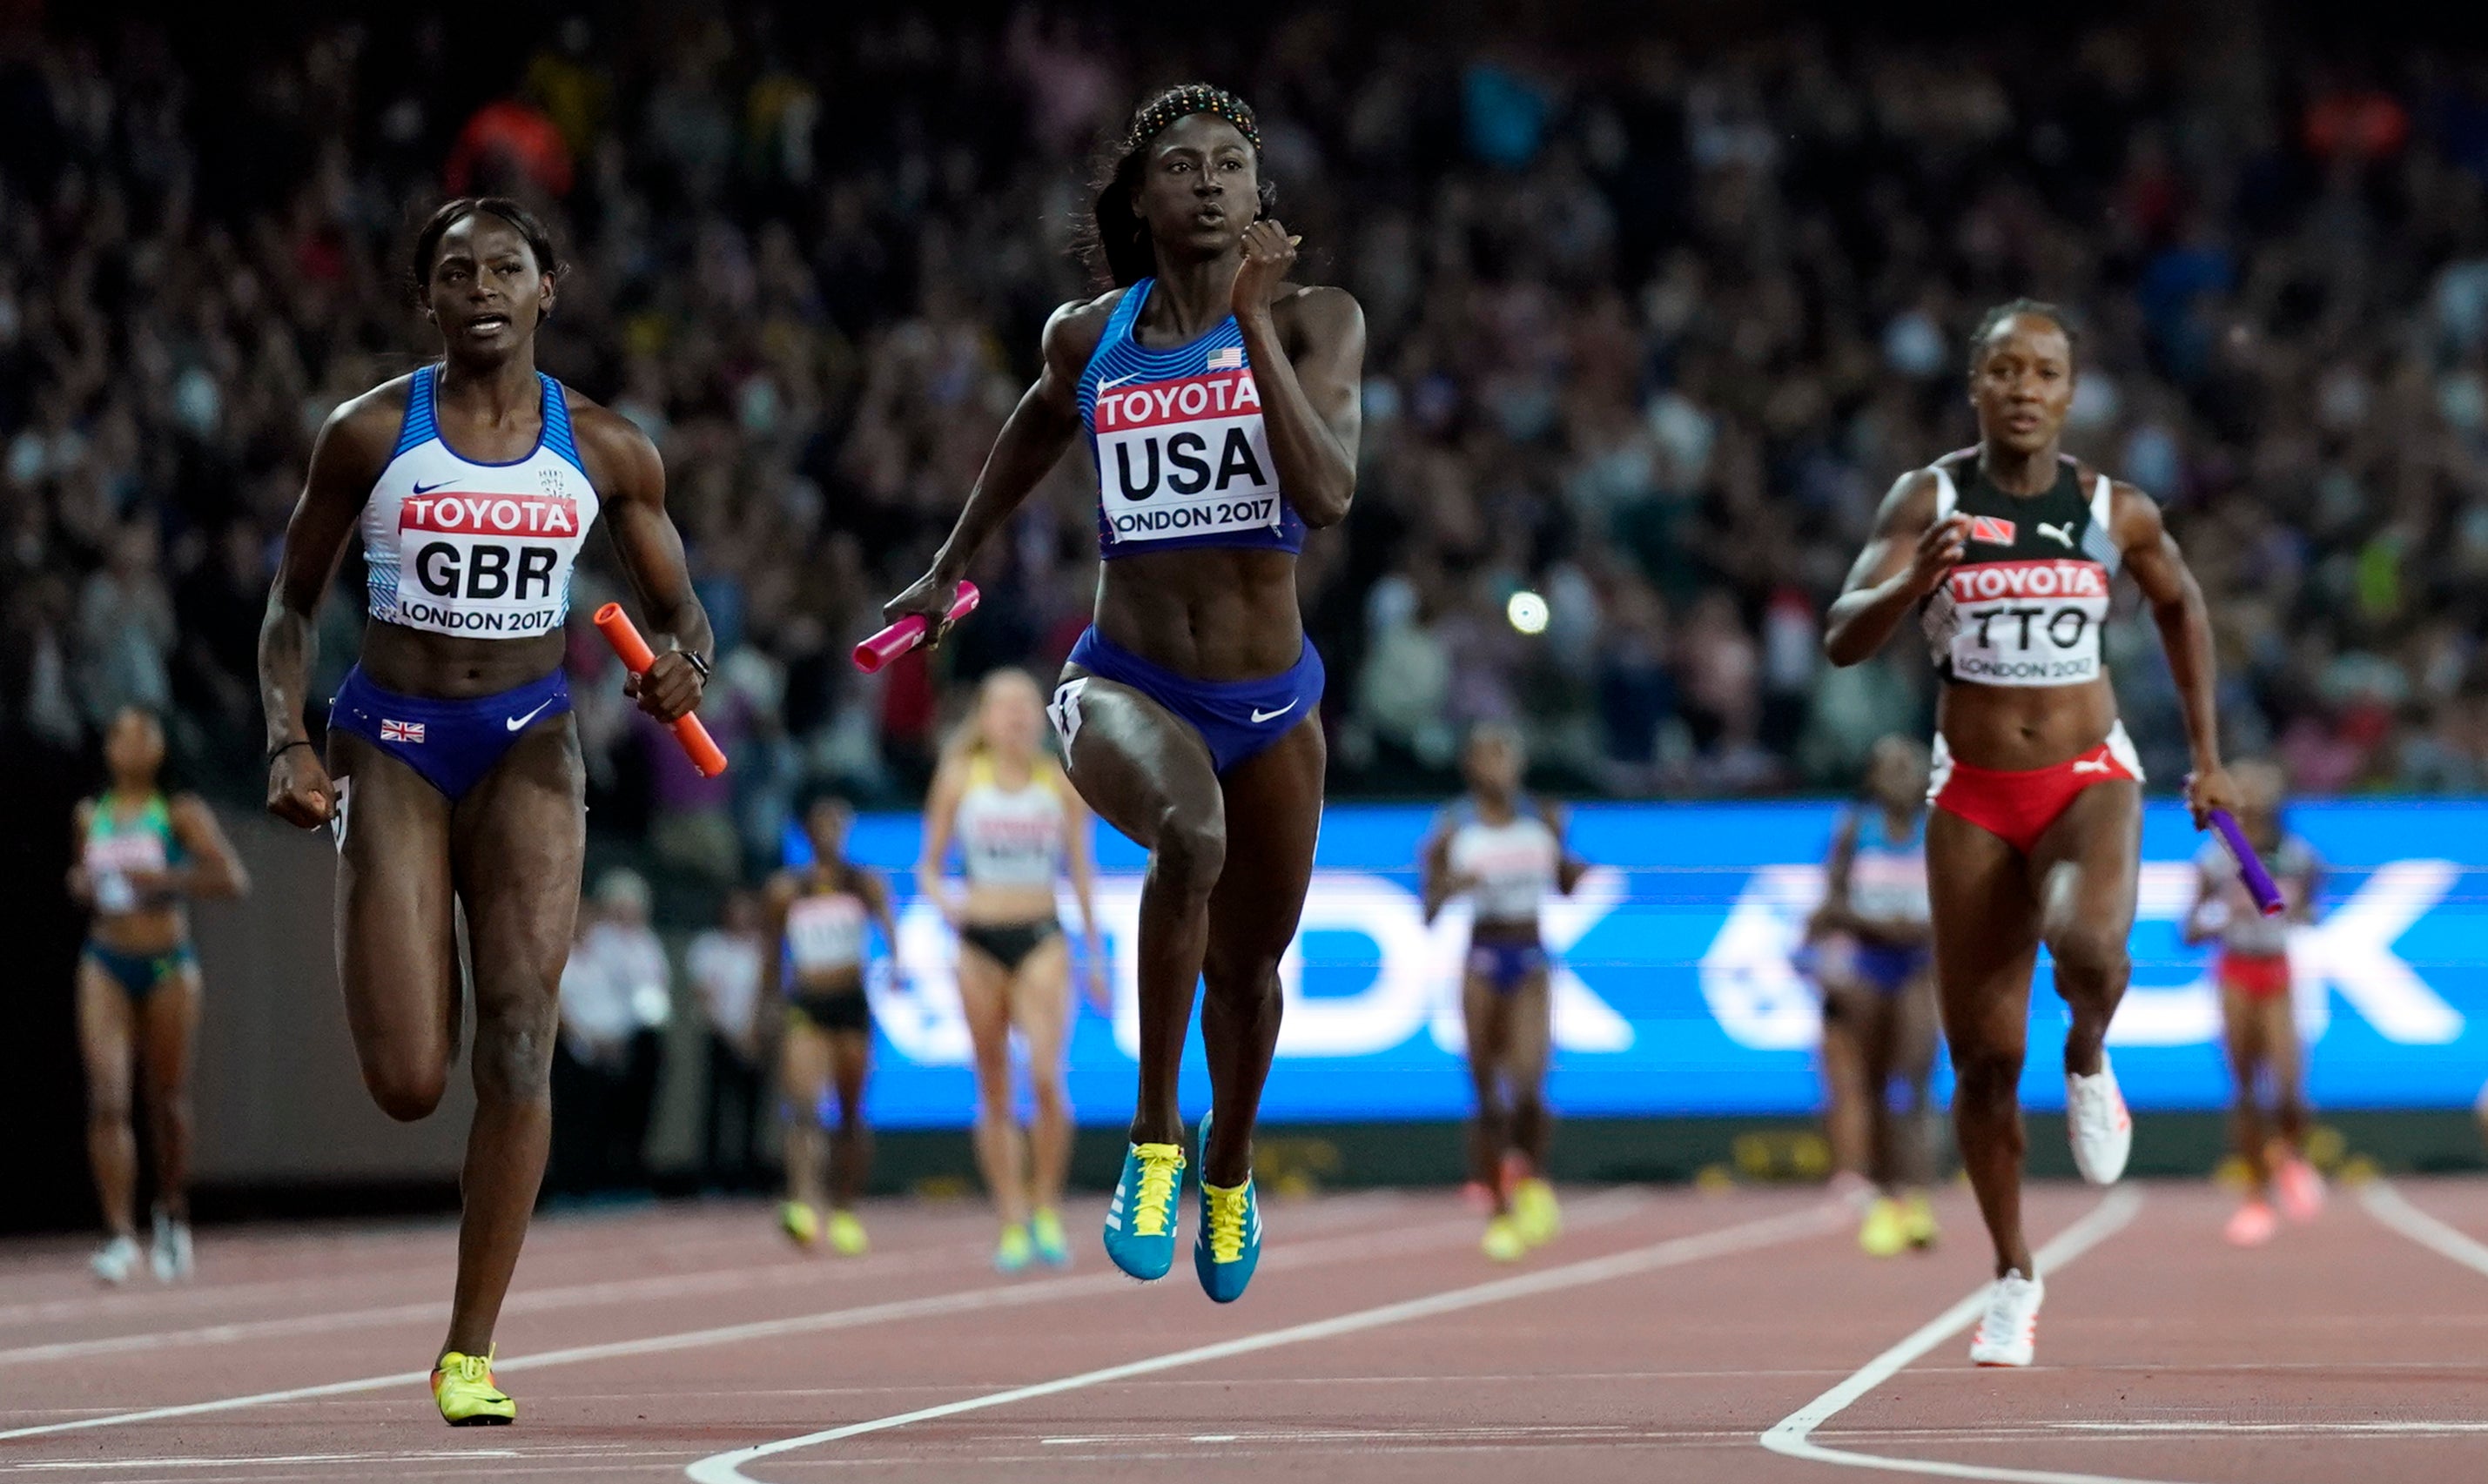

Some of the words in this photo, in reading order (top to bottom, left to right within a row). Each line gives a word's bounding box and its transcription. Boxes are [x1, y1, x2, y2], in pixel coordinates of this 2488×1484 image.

[1099, 377, 1261, 426] TOYOTA
[1115, 426, 1267, 501] USA
[408, 497, 572, 533] TOYOTA
[1217, 499, 1274, 524] 2017
[415, 541, 558, 600] GBR
[1955, 566, 2100, 598] TOYOTA
[402, 601, 502, 630] LONDON
[508, 609, 555, 630] 2017
[1972, 606, 2088, 651] TTO
